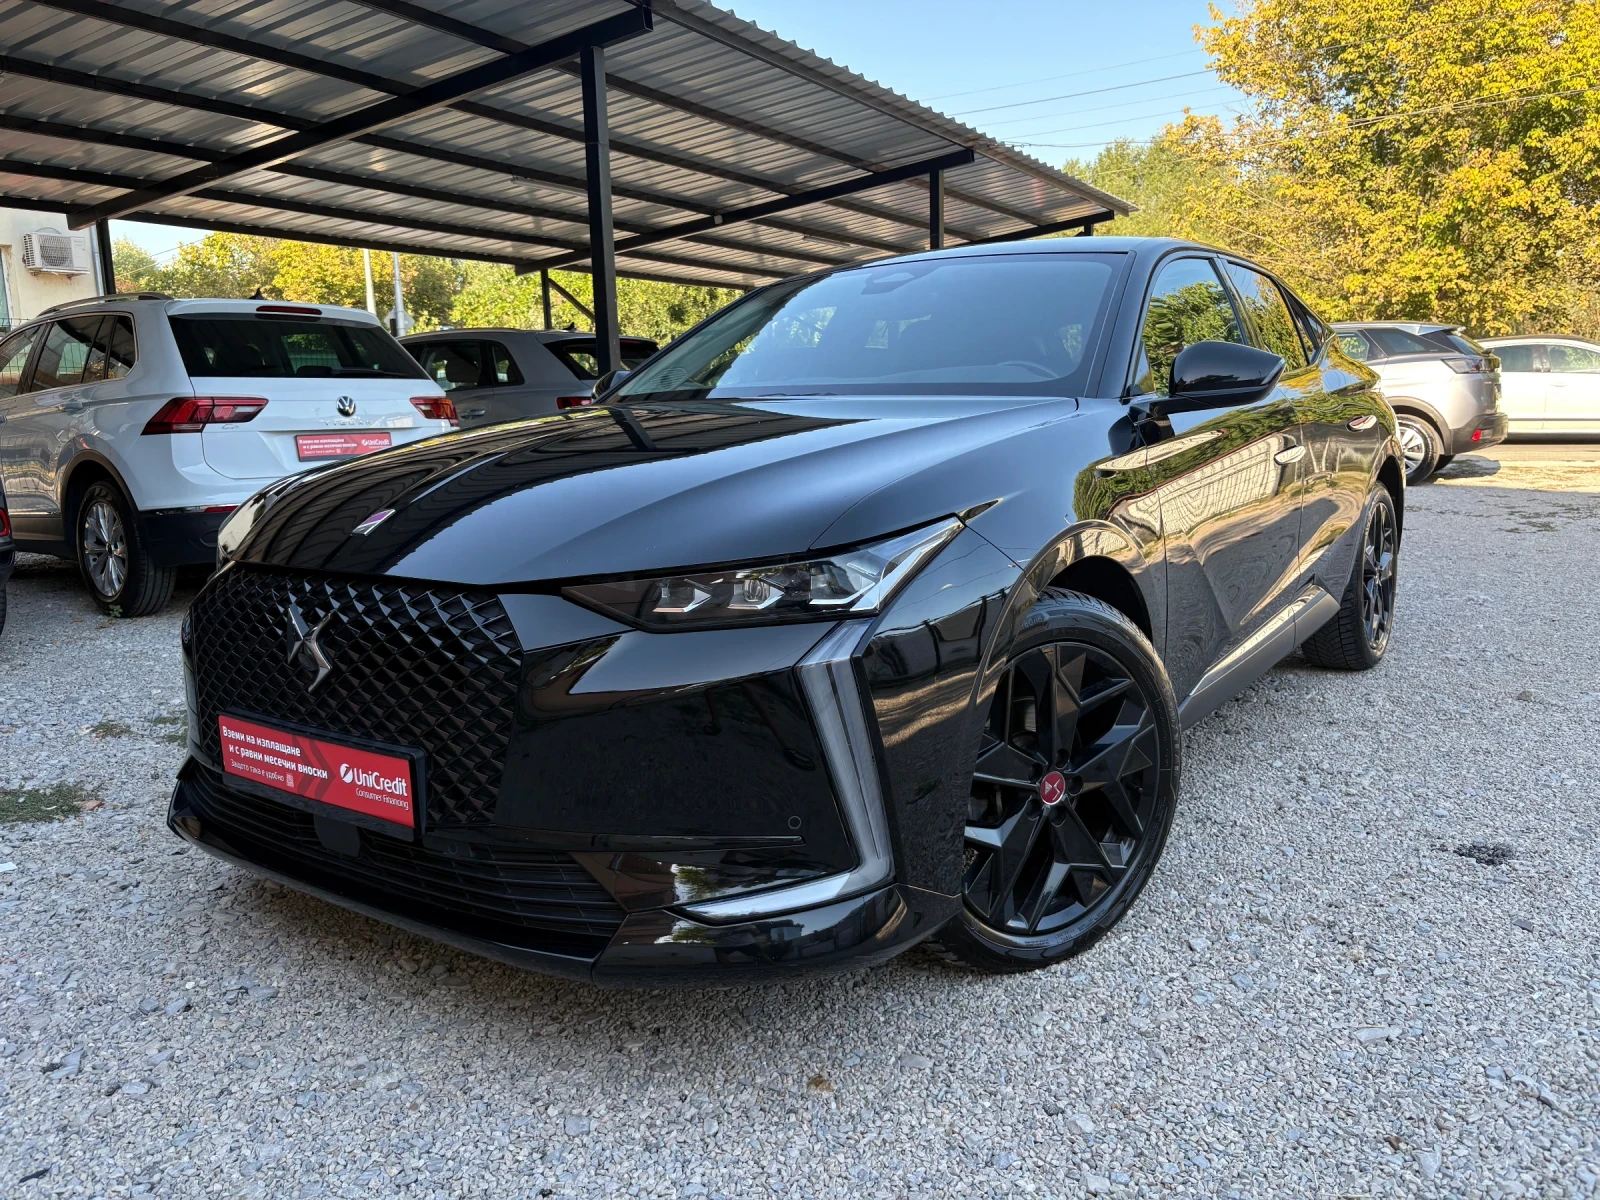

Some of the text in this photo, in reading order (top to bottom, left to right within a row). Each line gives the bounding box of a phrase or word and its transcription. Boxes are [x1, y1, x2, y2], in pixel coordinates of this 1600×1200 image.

[222, 726, 301, 757] Вземи на изплащане
[229, 744, 328, 779] и с равни месечни вноски
[354, 767, 408, 796] UniCredit
[355, 787, 409, 811] Consumer Financing
